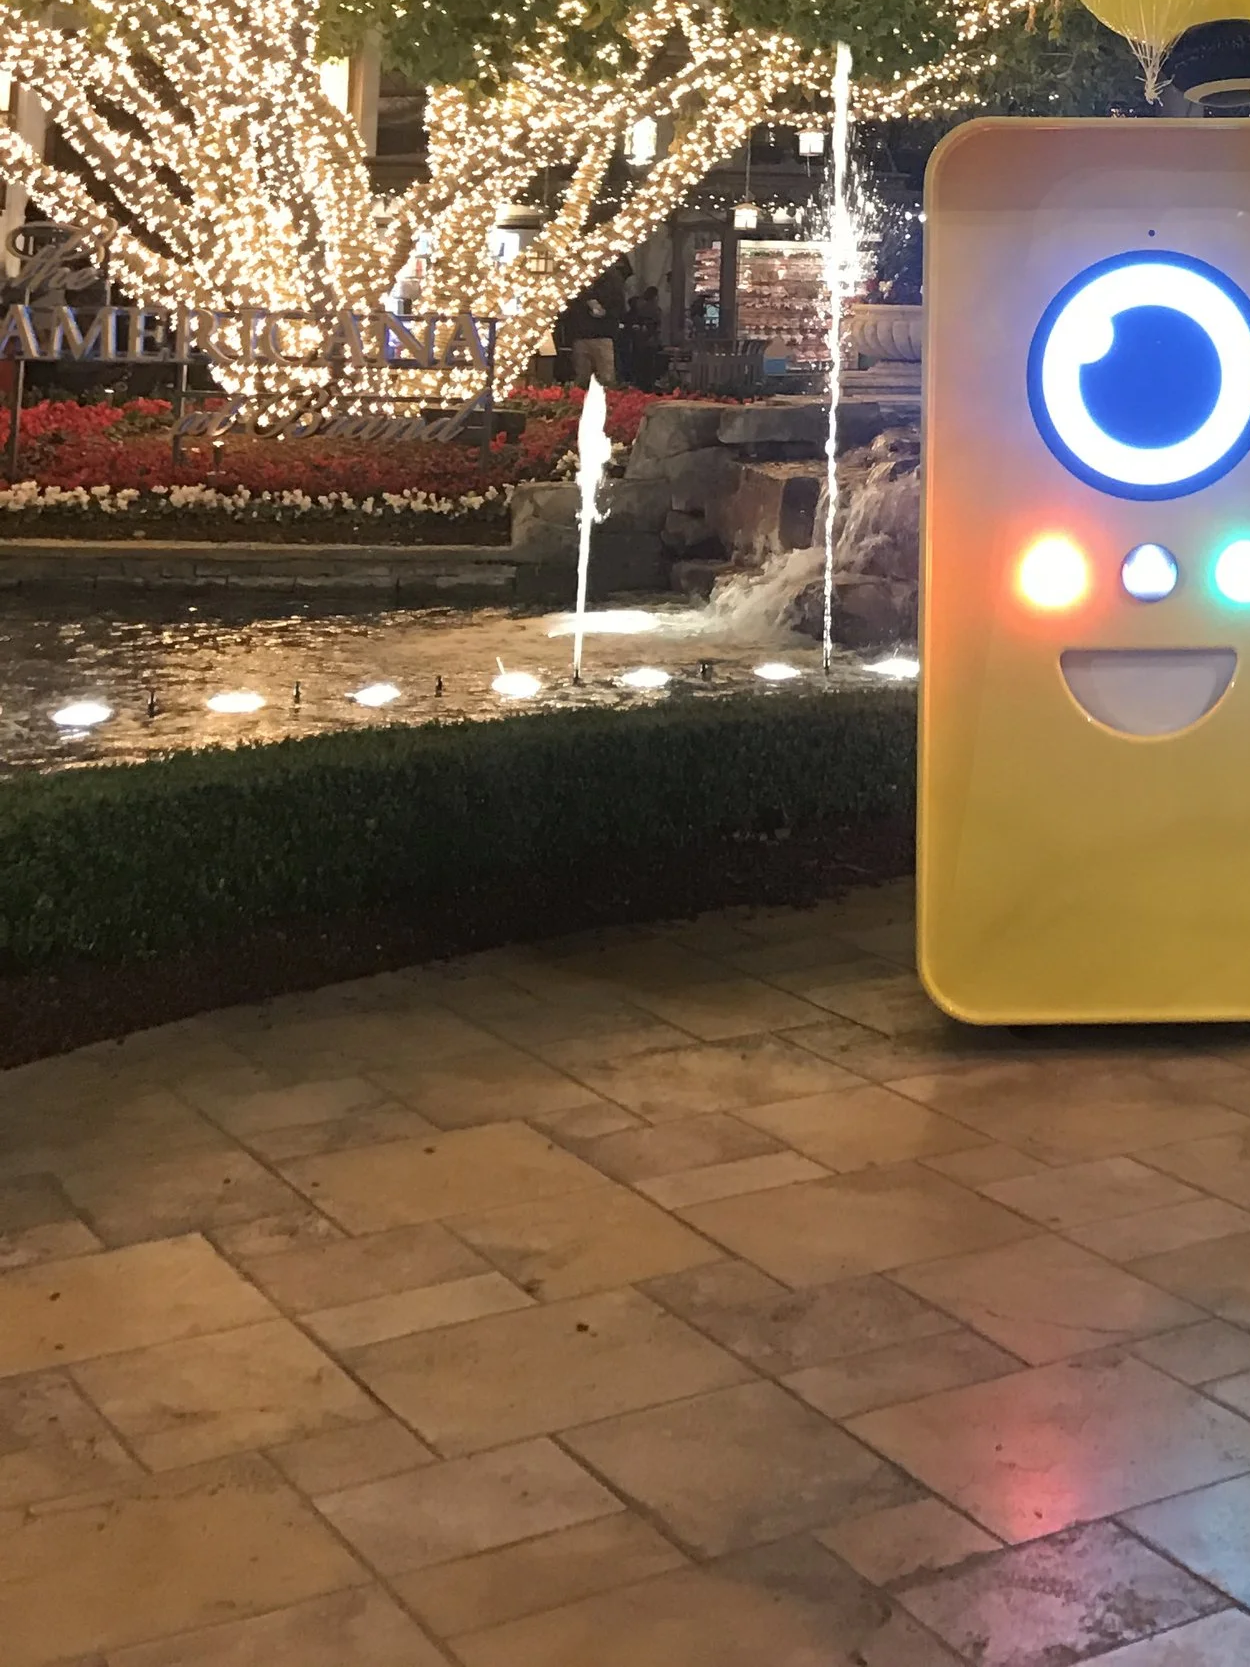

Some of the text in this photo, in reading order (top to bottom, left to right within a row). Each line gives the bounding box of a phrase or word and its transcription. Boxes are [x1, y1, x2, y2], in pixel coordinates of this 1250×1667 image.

[0, 304, 494, 370] AMERICANA
[172, 384, 491, 442] at Brand
